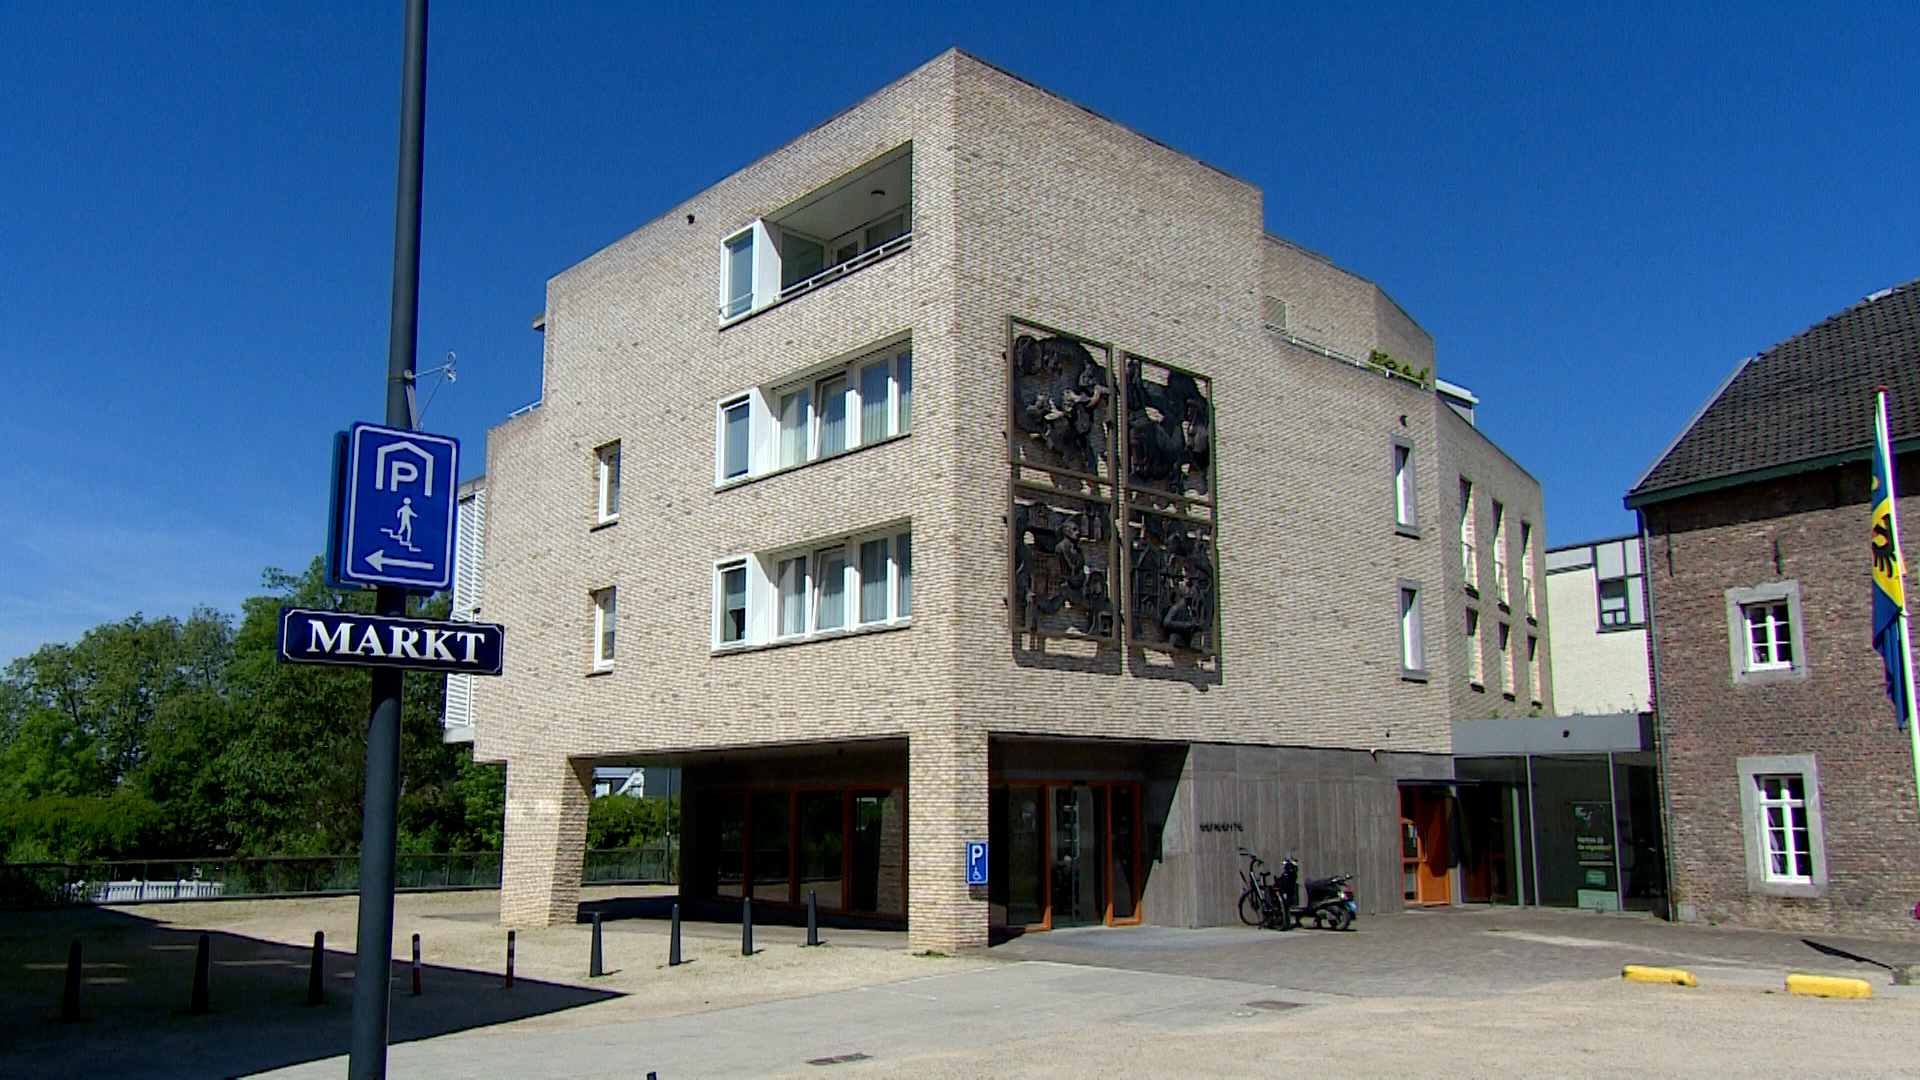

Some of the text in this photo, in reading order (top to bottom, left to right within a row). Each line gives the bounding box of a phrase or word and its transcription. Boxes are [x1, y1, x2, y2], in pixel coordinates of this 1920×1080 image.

[390, 461, 419, 492] P
[306, 619, 485, 664] MARKT
[972, 845, 983, 866] P
